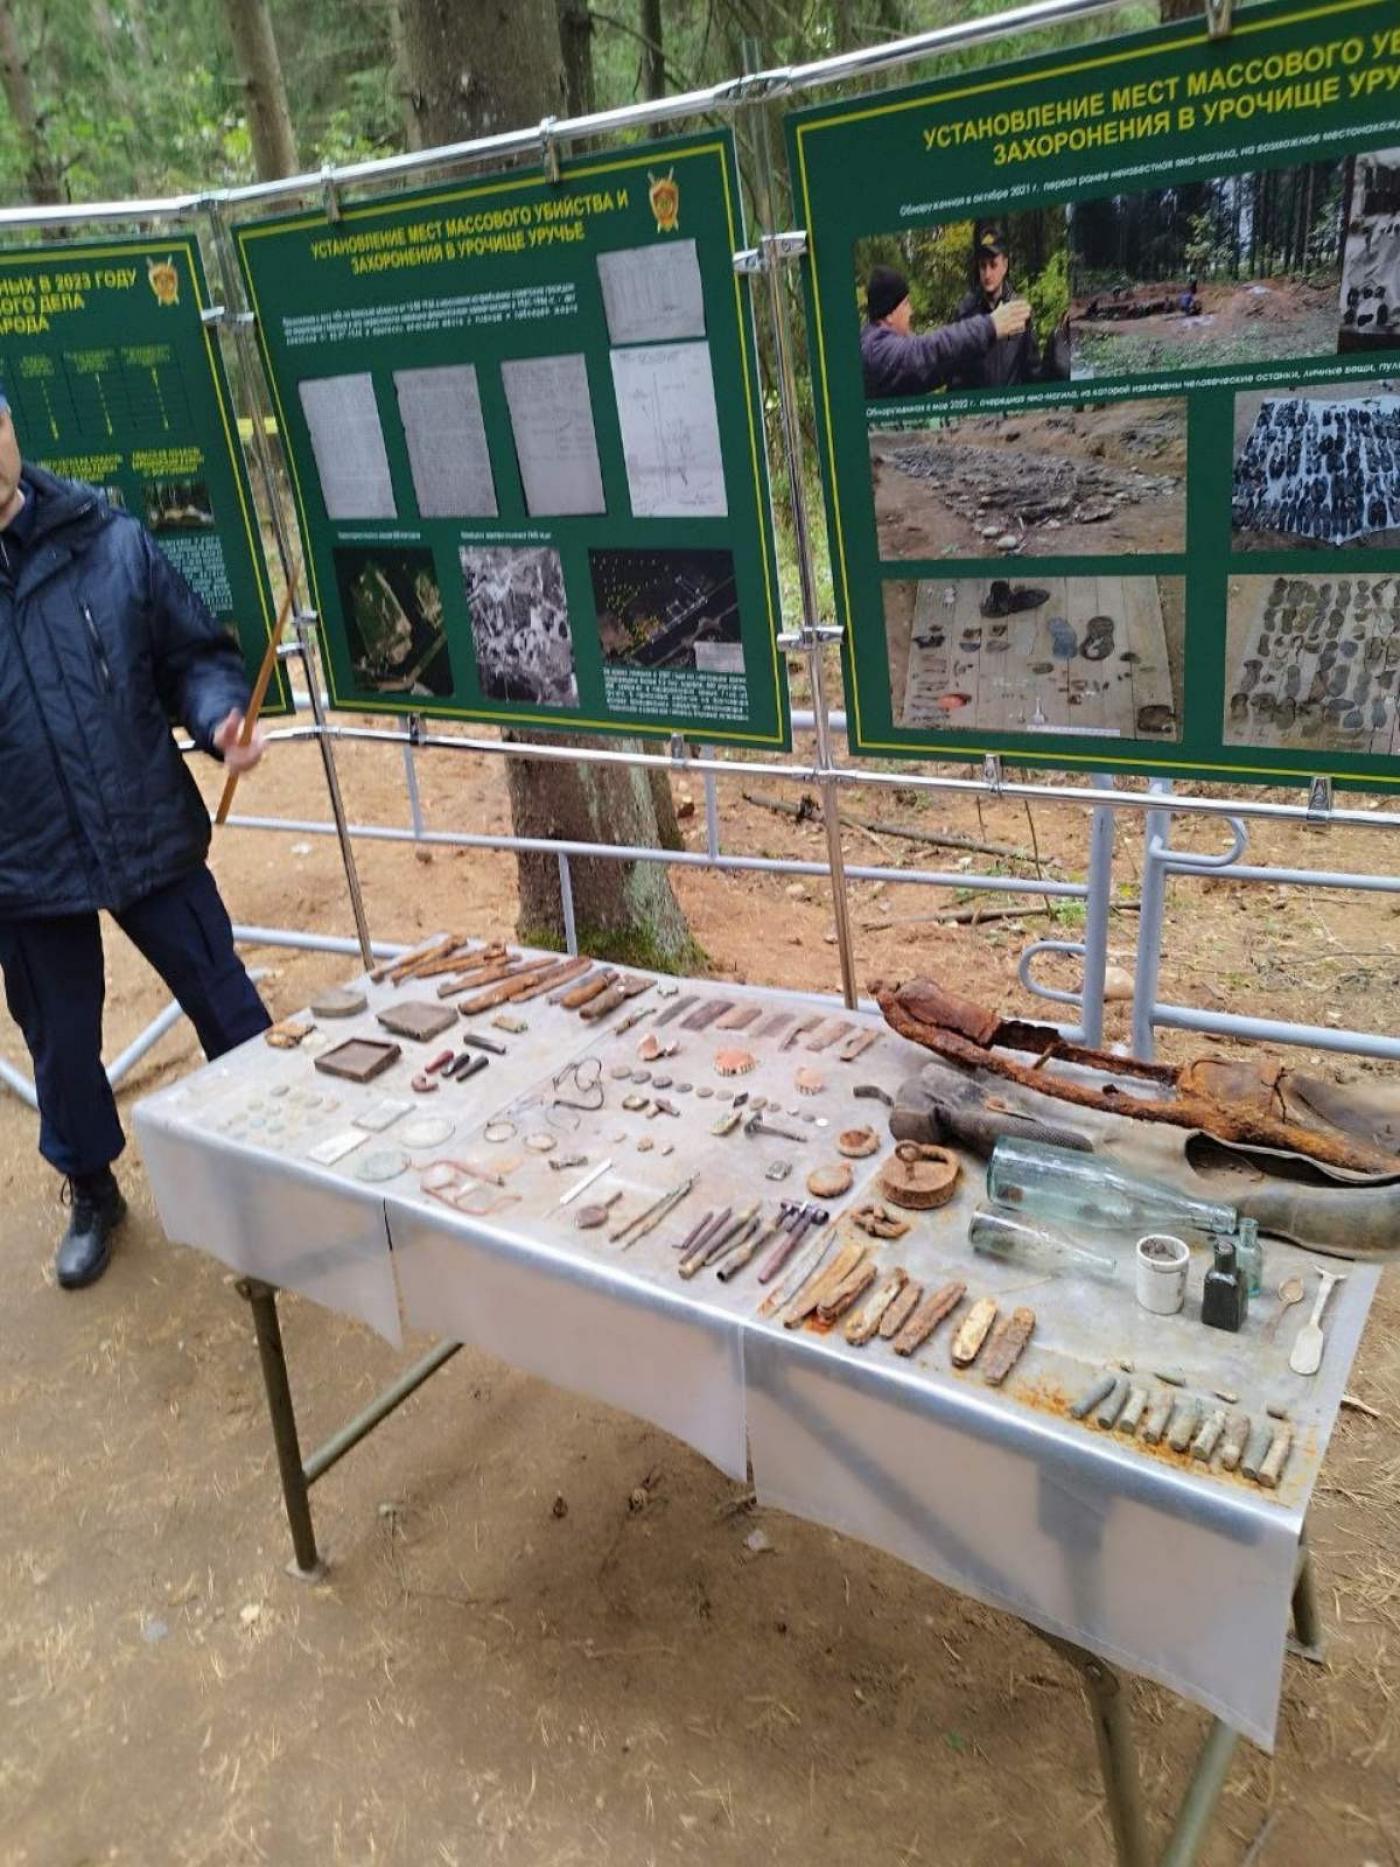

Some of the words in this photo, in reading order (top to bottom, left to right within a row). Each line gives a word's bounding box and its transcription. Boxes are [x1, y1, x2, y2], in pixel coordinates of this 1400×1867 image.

[923, 93, 1105, 151] УСТАНОВЛЕНИЕ
[1112, 76, 1181, 113] МЕСТ
[1187, 38, 1364, 97] МАССОВОГО
[993, 111, 1171, 166] ЗАХОРОНЕНИЯ
[1178, 106, 1195, 130] В
[1203, 76, 1340, 126] УРОЧИЩЕ
[311, 227, 406, 262] УСТАНОВЛЕНИЕ
[408, 220, 441, 244] МЕСТ
[446, 206, 531, 238] МАССОВОГО
[534, 191, 614, 223] УБИЙСТВА
[617, 188, 629, 209] И
[351, 242, 443, 275] ЗАХОРОНЕНИЯ
[446, 241, 456, 260] В
[457, 230, 526, 258] УРОЧИЩЕ
[528, 220, 585, 248] УРУЧЬЕ
[0, 295, 36, 316] ОГО
[40, 292, 85, 316] ДЕЛА
[39, 274, 51, 294] В
[95, 267, 136, 290] ГОДУ
[1378, 360, 1400, 373] пул
